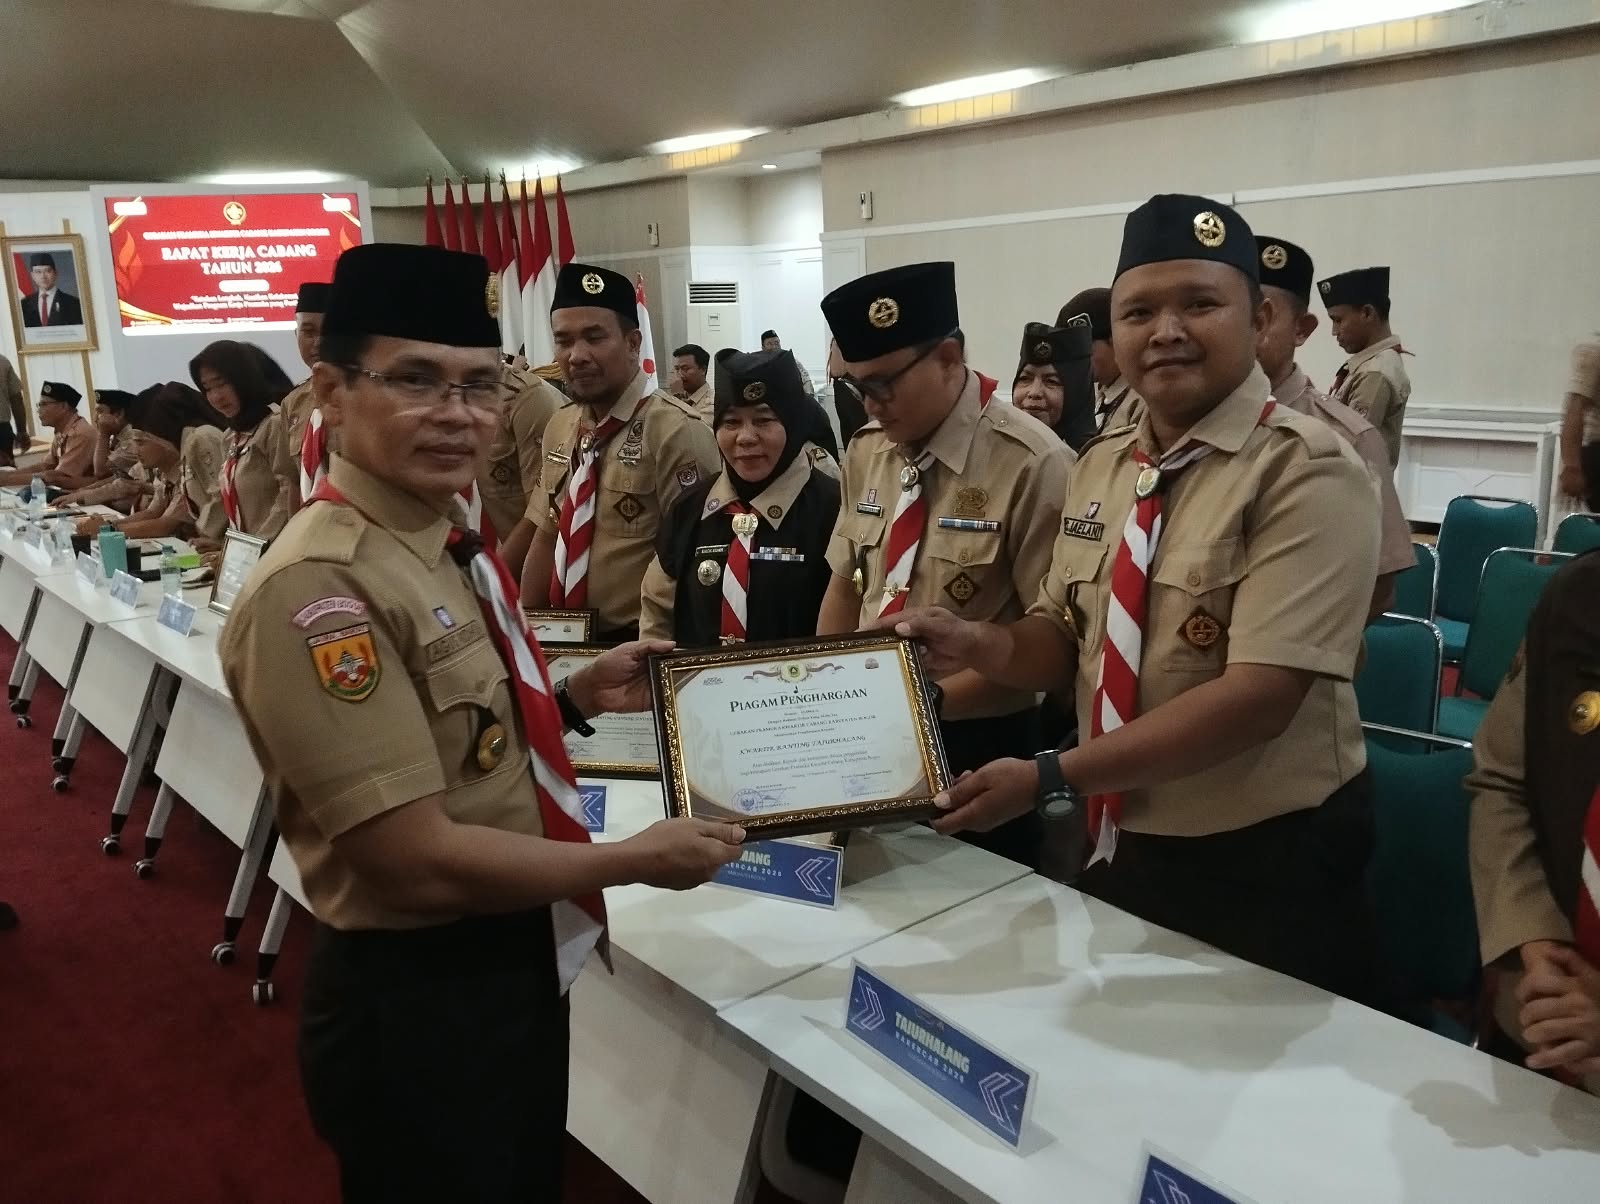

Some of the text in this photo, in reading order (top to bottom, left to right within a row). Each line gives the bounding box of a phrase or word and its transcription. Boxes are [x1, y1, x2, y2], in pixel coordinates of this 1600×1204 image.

[161, 243, 317, 261] RAPAT KERJA CABANG
[201, 261, 253, 275] TAHUN
[730, 688, 868, 712] PIAGAM PENGHARGAAN
[895, 1011, 970, 1074] TAJURHALANG
